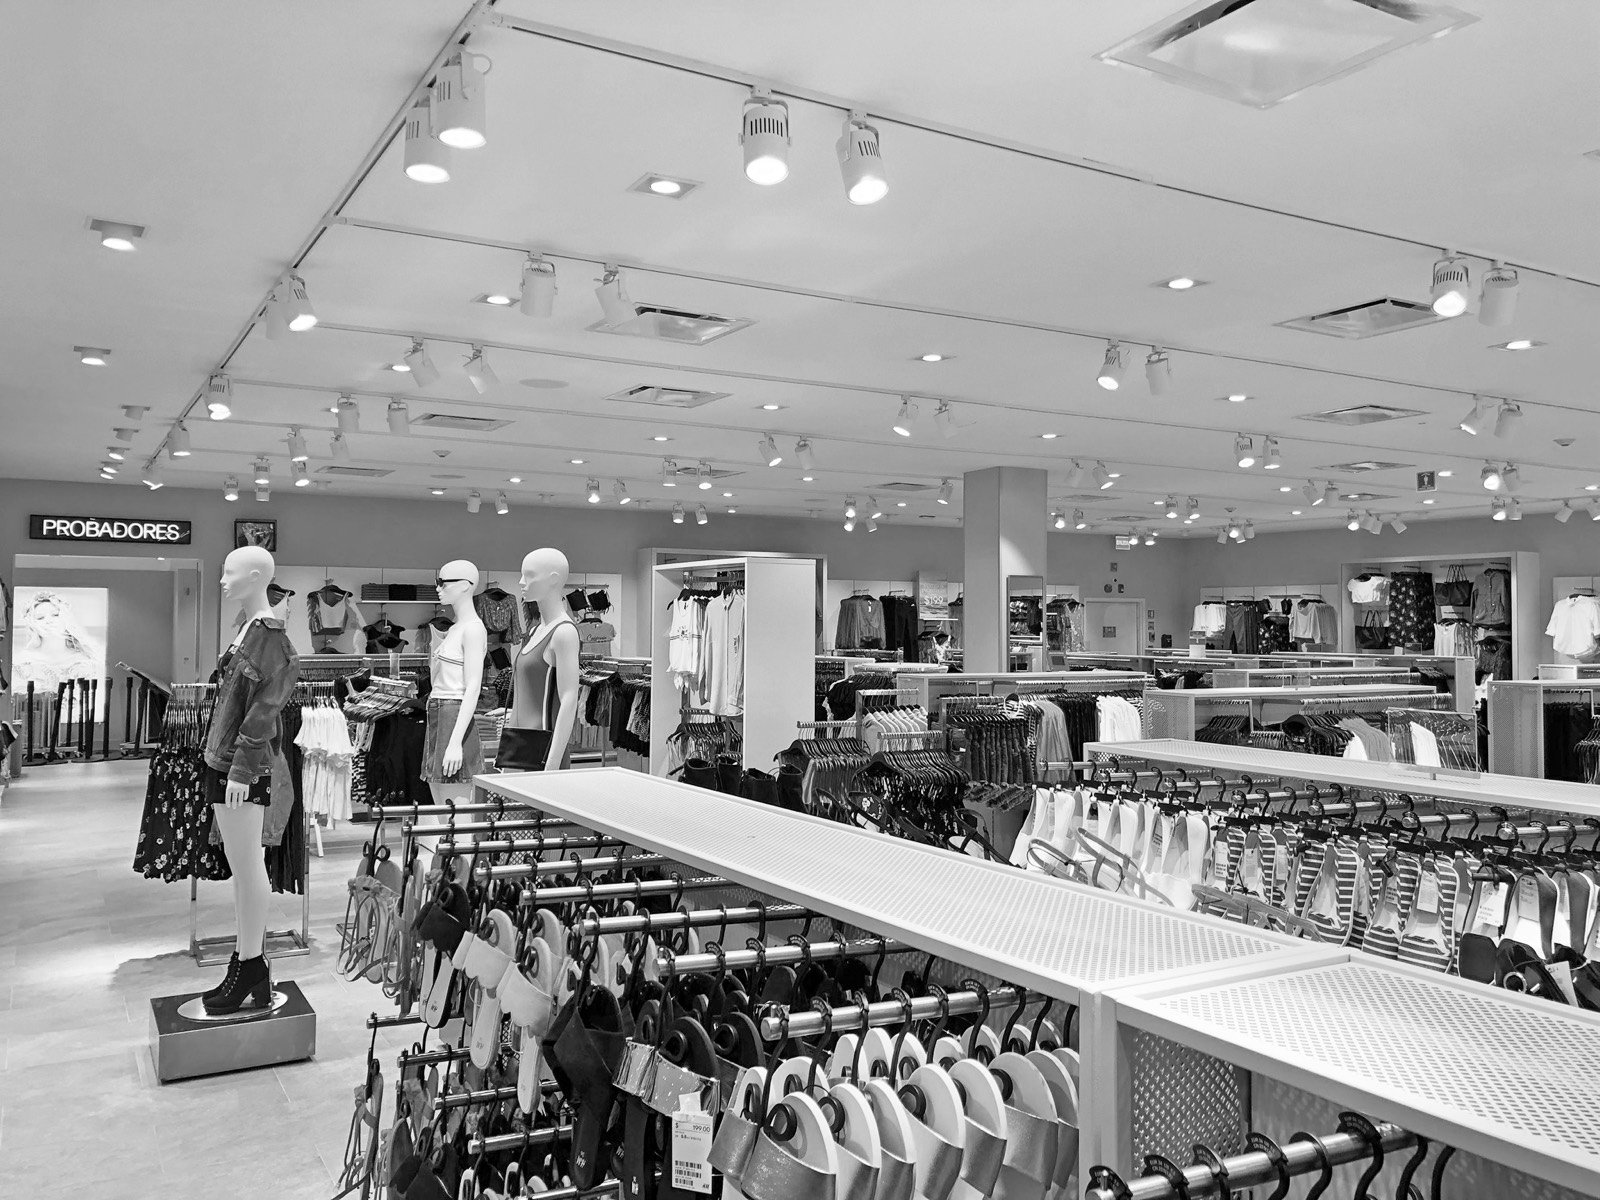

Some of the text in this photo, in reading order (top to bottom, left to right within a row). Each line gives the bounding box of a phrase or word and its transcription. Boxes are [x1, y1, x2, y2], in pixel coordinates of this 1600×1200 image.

[42, 519, 181, 541] PROBADORES
[924, 595, 944, 606] $199
[692, 1124, 711, 1133] 199.00
